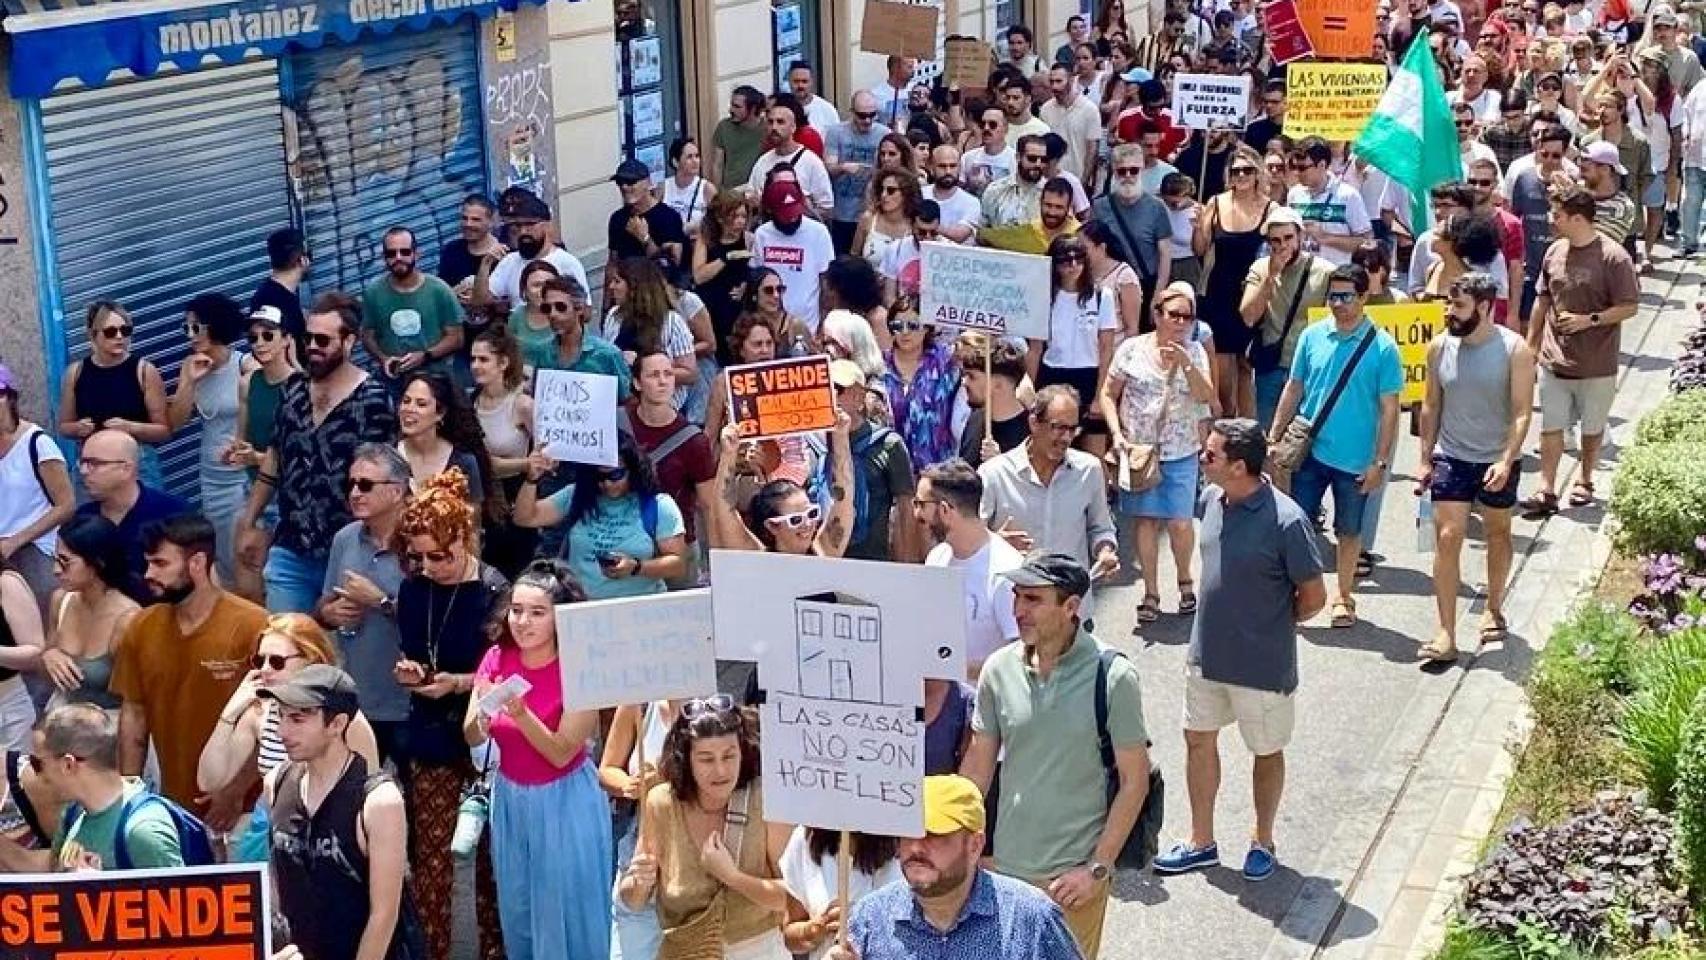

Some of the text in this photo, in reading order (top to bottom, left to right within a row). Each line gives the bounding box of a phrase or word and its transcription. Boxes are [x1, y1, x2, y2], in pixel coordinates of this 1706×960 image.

[159, 3, 320, 54] montañez
[1289, 69, 1384, 88] LAS VIVIENDAS
[1186, 104, 1237, 116] FUERZA
[929, 250, 1016, 279] QUEREMOS
[935, 304, 1006, 328] ABIERTA
[731, 363, 830, 396] SE VENDE
[778, 701, 918, 737] LAS CASAS
[802, 728, 917, 769] NO SON
[775, 758, 917, 808] HOTELES
[1, 883, 253, 945] SE VENDE
